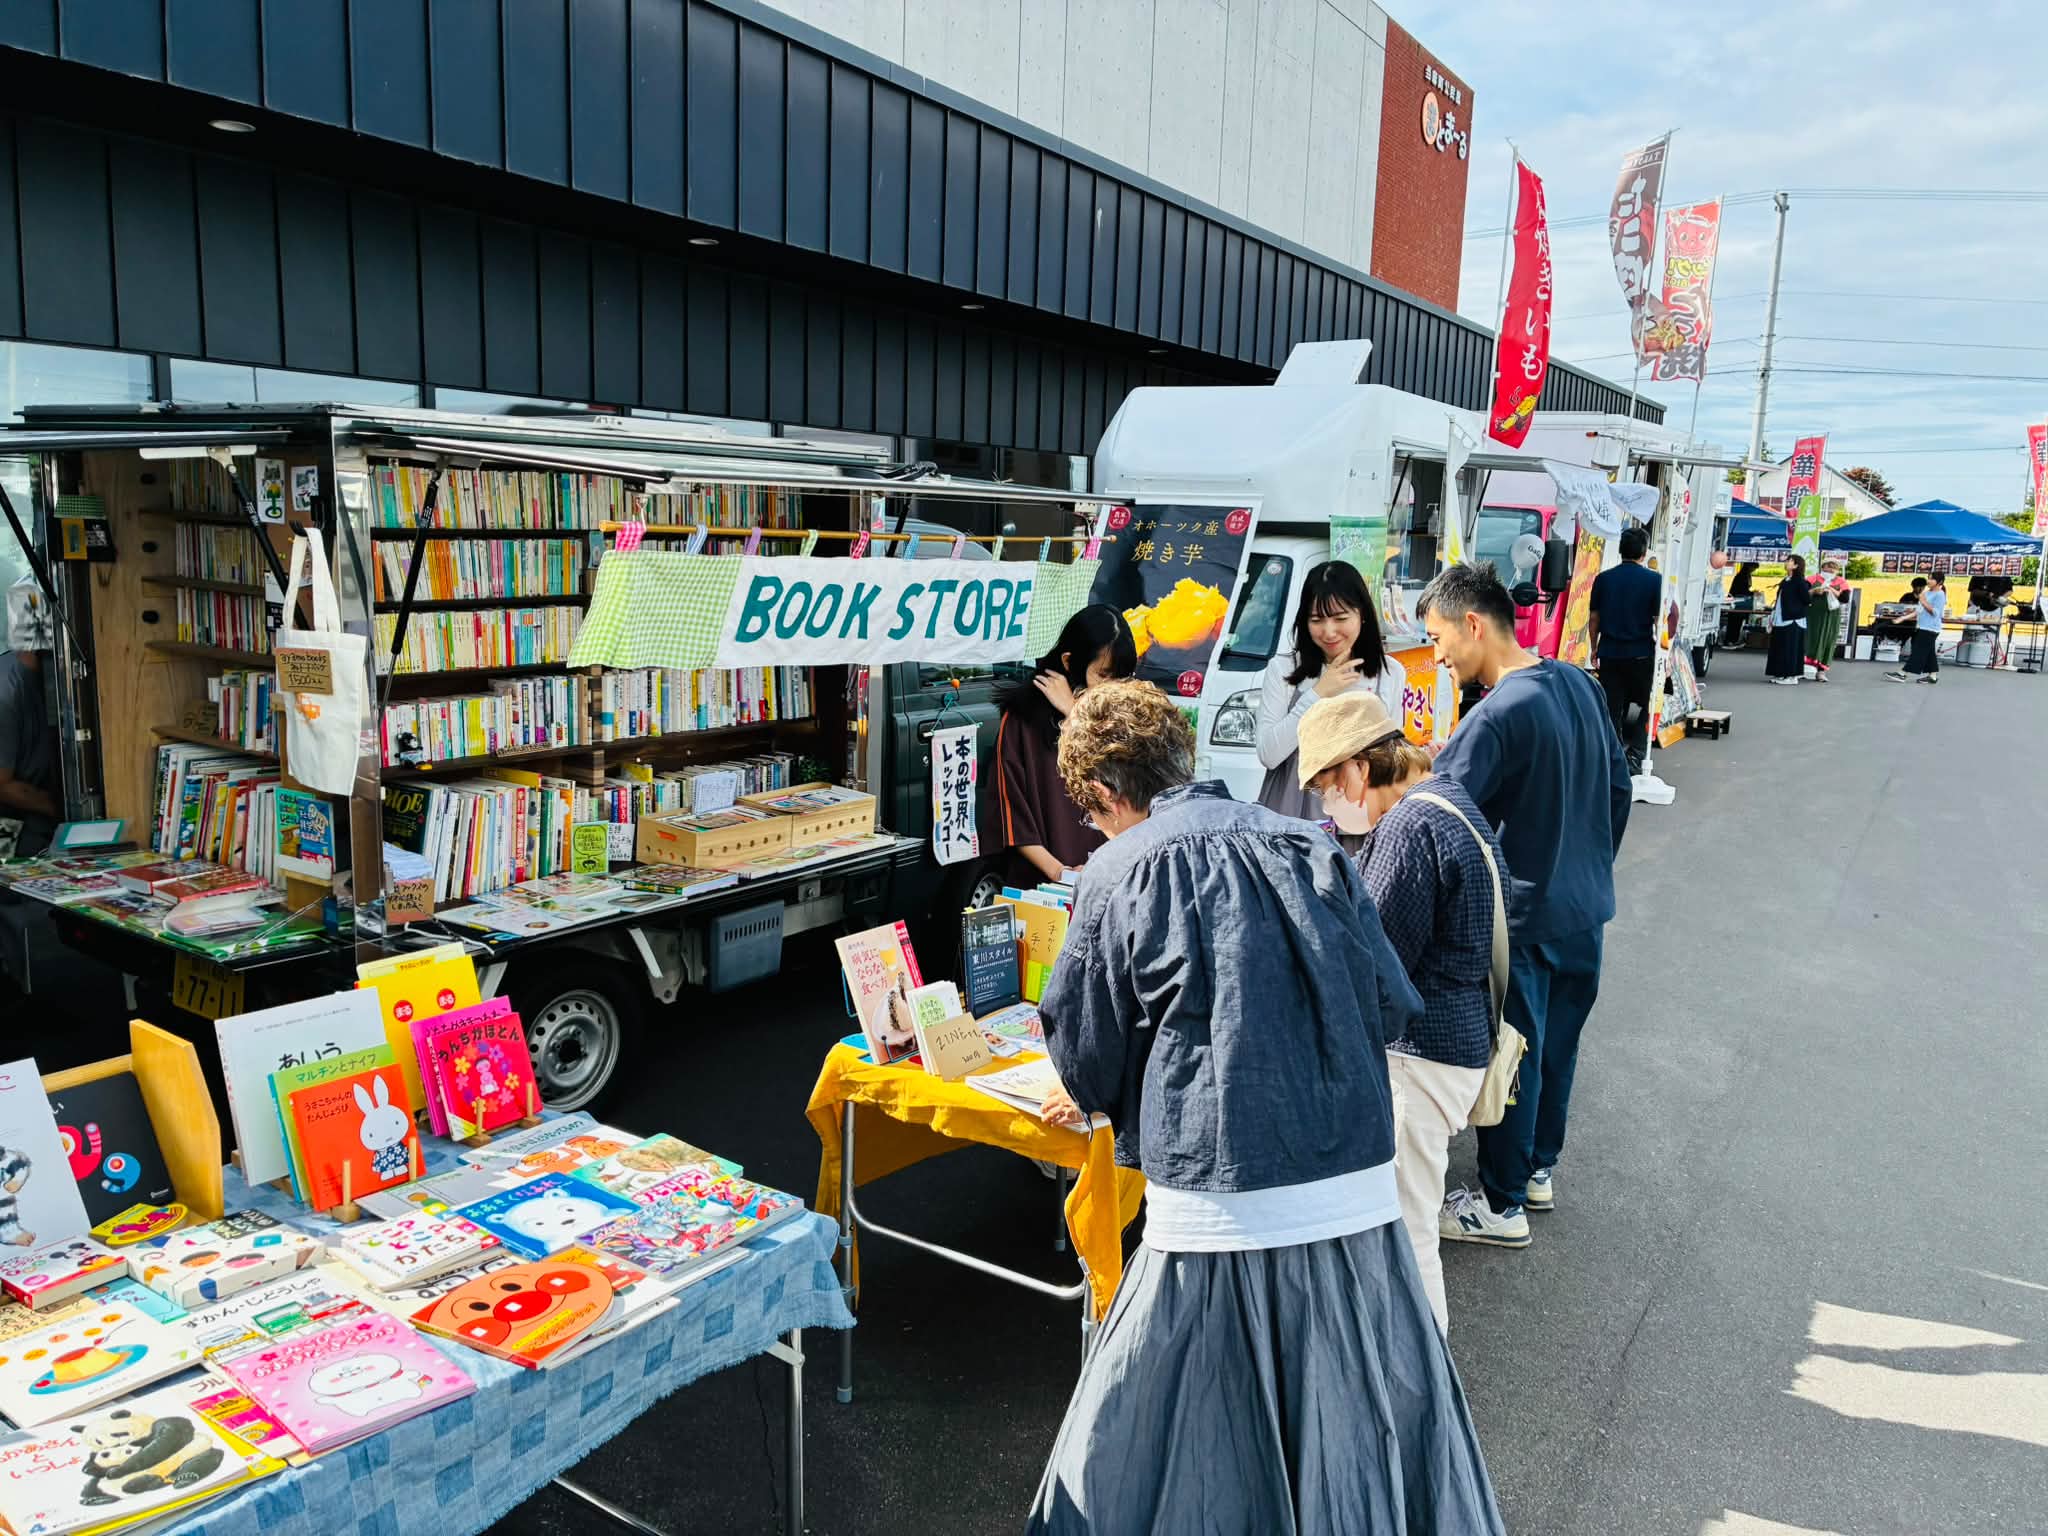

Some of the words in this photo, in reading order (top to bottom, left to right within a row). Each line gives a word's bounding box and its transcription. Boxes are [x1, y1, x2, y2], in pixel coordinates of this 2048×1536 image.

[1132, 519, 1219, 536] オホーツク産
[1131, 541, 1204, 566] 焼き芋
[735, 575, 881, 643] BOOK
[887, 578, 1032, 641] STORE
[955, 735, 971, 844] 本の世界へ
[851, 947, 880, 966] 病気に
[857, 959, 889, 980] ならない
[862, 975, 888, 996] 食べ方
[296, 1053, 377, 1082] マルチンとナイフ
[303, 1090, 352, 1112] うさこちゃんの
[307, 1103, 349, 1124] たんじょうび
[32, 1452, 49, 1464] と
